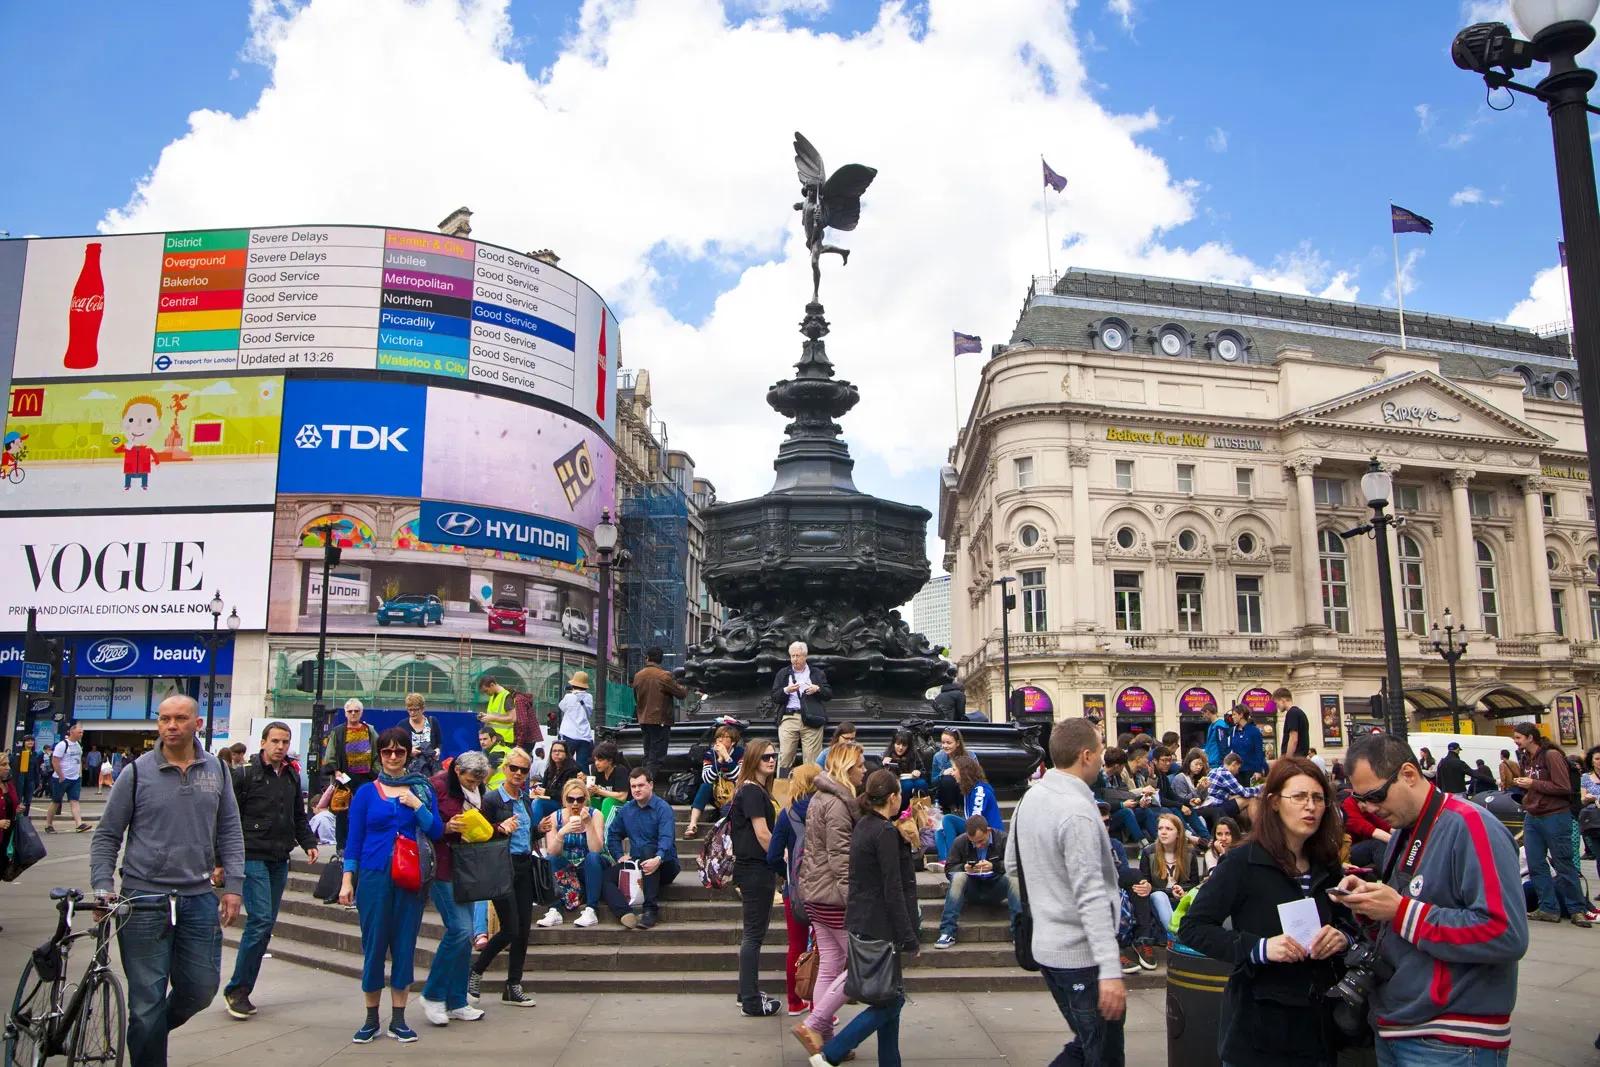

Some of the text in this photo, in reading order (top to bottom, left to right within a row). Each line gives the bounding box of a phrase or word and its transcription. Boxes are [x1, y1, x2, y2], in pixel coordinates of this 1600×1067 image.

[167, 237, 202, 248] District
[252, 232, 328, 244] Severe Delays
[164, 255, 226, 268] Overground
[250, 251, 327, 263] Severe Delays
[386, 254, 426, 266] Jubilee
[478, 248, 540, 274] Good Service
[162, 276, 208, 287] Bakerloo
[248, 271, 320, 282] Good Service
[384, 272, 454, 291] Metropolitan
[477, 268, 539, 292] Good Service
[160, 296, 198, 307] Central
[246, 291, 318, 302] Good Service
[384, 293, 433, 308] Northern
[476, 286, 538, 312] Good Service
[244, 312, 316, 323] Good Service
[382, 313, 436, 330] Piccadilly
[474, 306, 538, 331] Good Service
[156, 337, 180, 347] DLR
[242, 332, 315, 344] Good Service
[380, 334, 423, 347] Victoria
[474, 326, 536, 350] Good Service
[174, 357, 202, 365] Transport
[240, 352, 334, 366] Updated at 13:26
[472, 346, 536, 369] Good Service
[380, 354, 466, 376] Waterloo & City
[472, 366, 535, 388] Good Service
[322, 424, 409, 452] TDK
[1106, 426, 1150, 442] Believe
[1168, 435, 1179, 445] or
[1181, 432, 1210, 448] Not!
[1213, 437, 1263, 450] MUSEUM
[486, 520, 570, 552] HYUNDAI
[20, 542, 204, 593] VOGUE
[312, 584, 360, 596] HUNDAI
[8, 604, 212, 615] PRIN AND DIGITAL EDITIONS ON SALE NOW
[92, 644, 129, 664] Boots
[153, 646, 206, 663] beauty
[204, 681, 224, 690] W're
[1406, 839, 1422, 866] Canon
